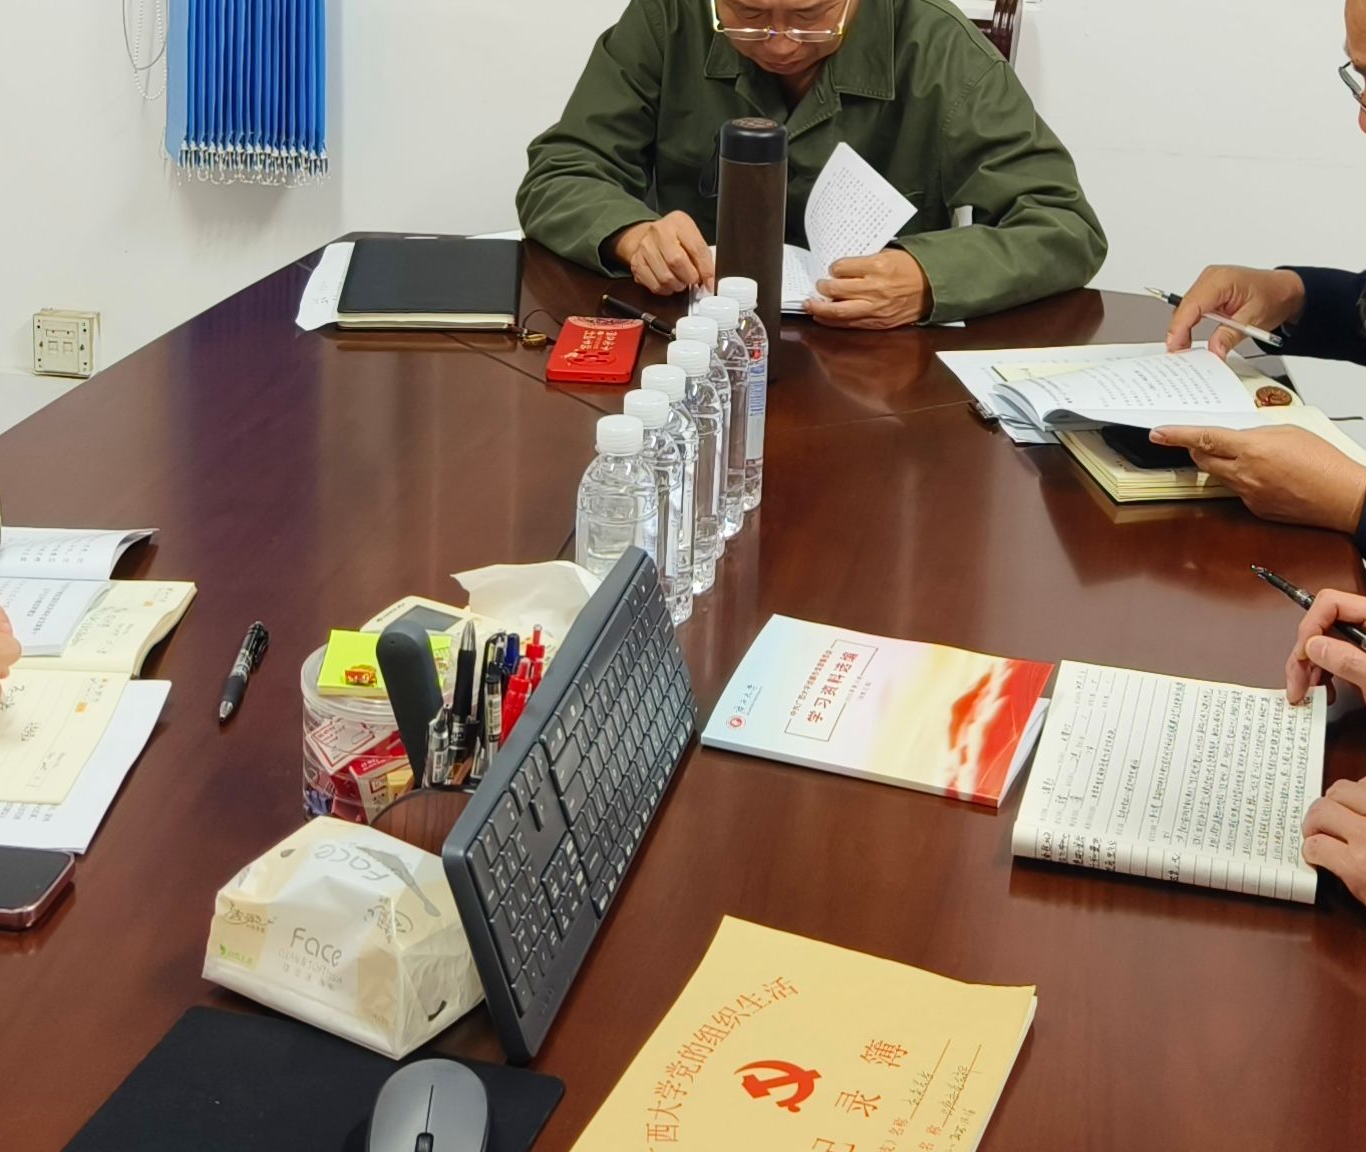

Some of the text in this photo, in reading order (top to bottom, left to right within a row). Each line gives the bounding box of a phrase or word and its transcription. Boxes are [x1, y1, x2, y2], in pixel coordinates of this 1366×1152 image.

[806, 651, 859, 724] 学习资料选编
[315, 843, 390, 882] Face
[290, 927, 343, 967] Face
[646, 976, 799, 1152] 西大学党的组织生活
